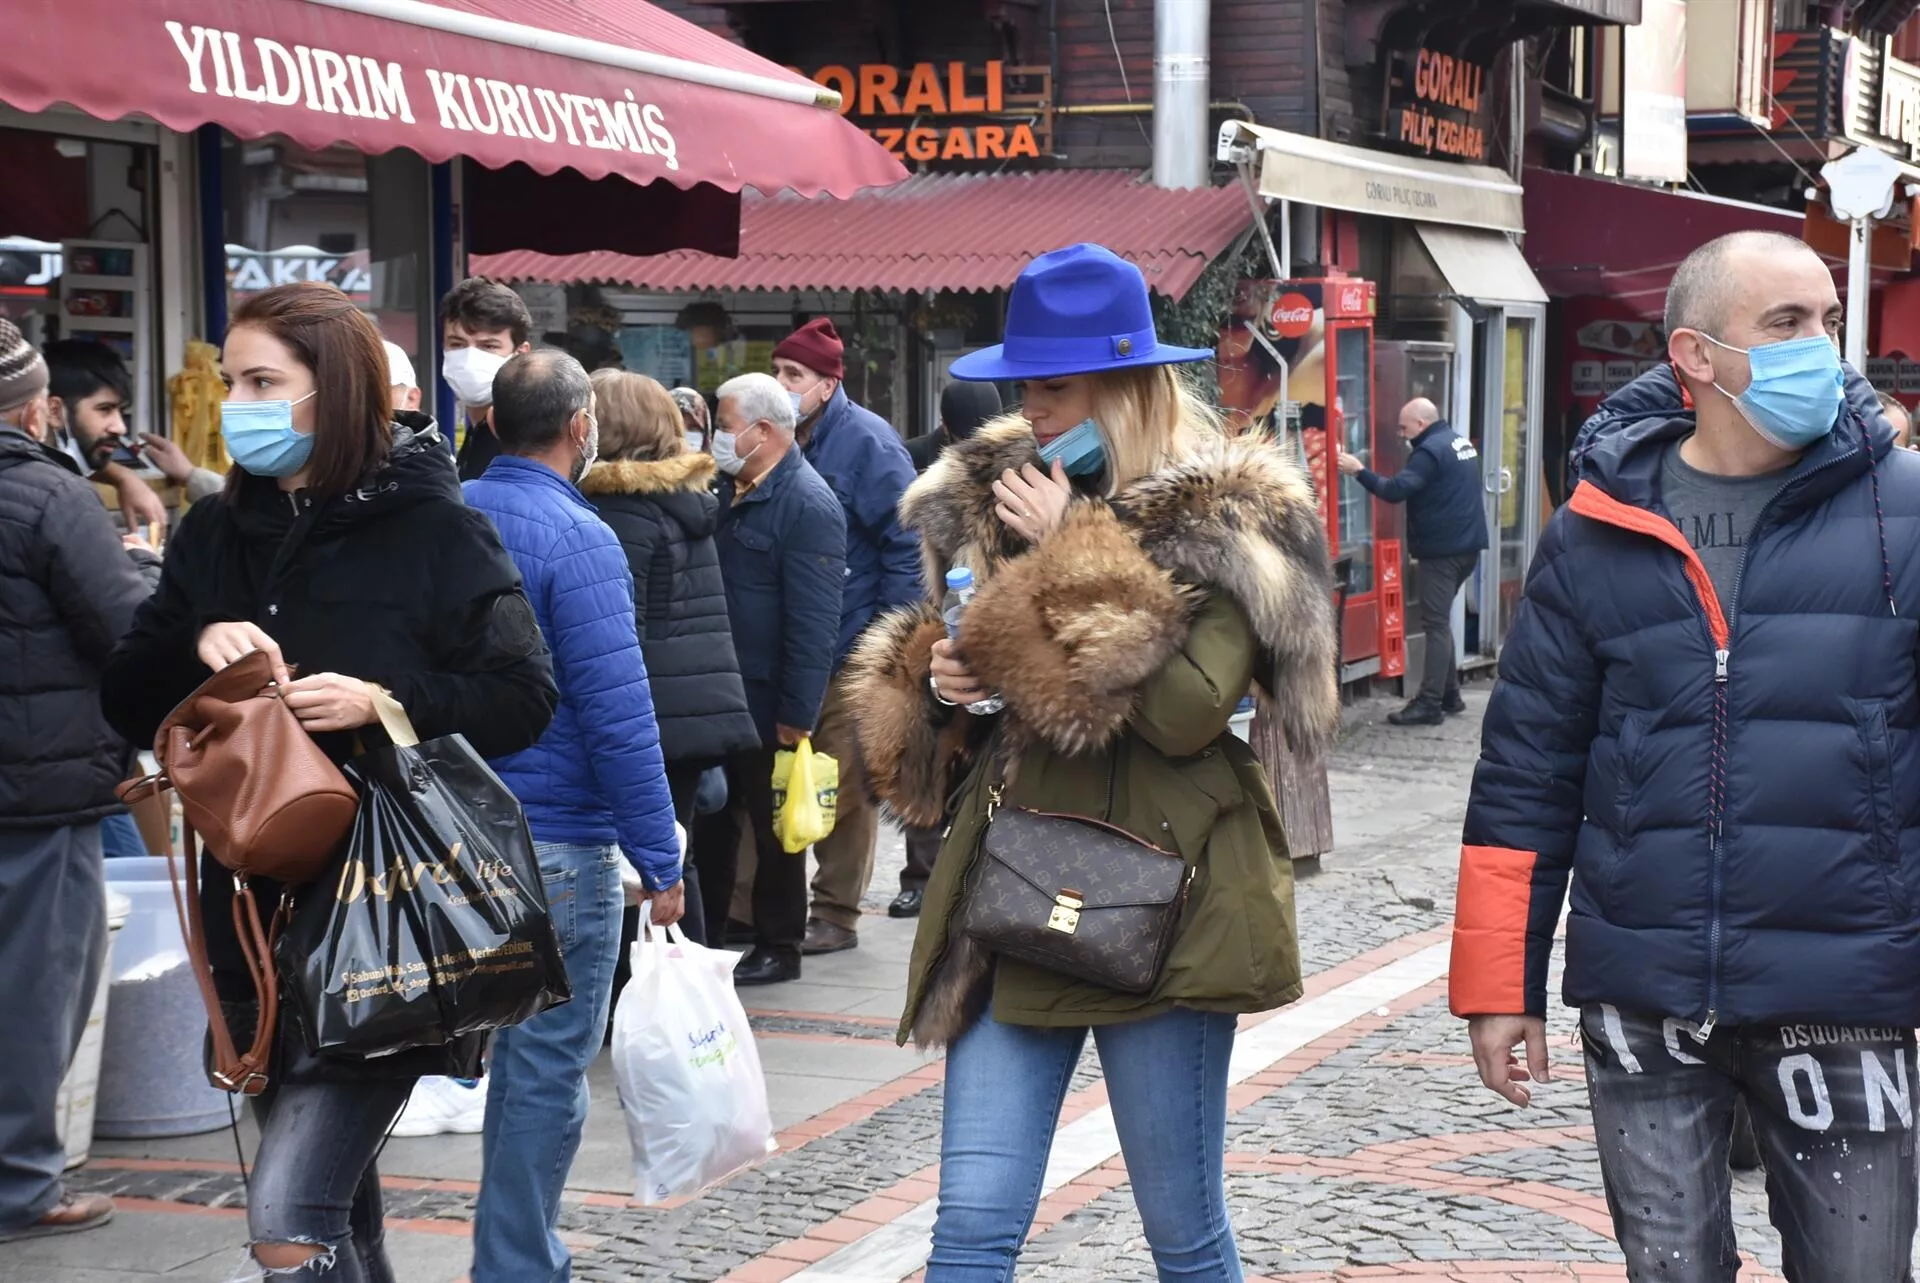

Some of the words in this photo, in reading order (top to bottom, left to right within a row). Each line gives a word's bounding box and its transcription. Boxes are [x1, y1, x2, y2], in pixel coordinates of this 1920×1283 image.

[165, 20, 416, 124] YILDIRIM
[425, 69, 679, 170] KURUYEMİŞ
[784, 60, 1004, 117] ORALI
[1415, 47, 1481, 114] GORALI
[475, 858, 513, 883] life
